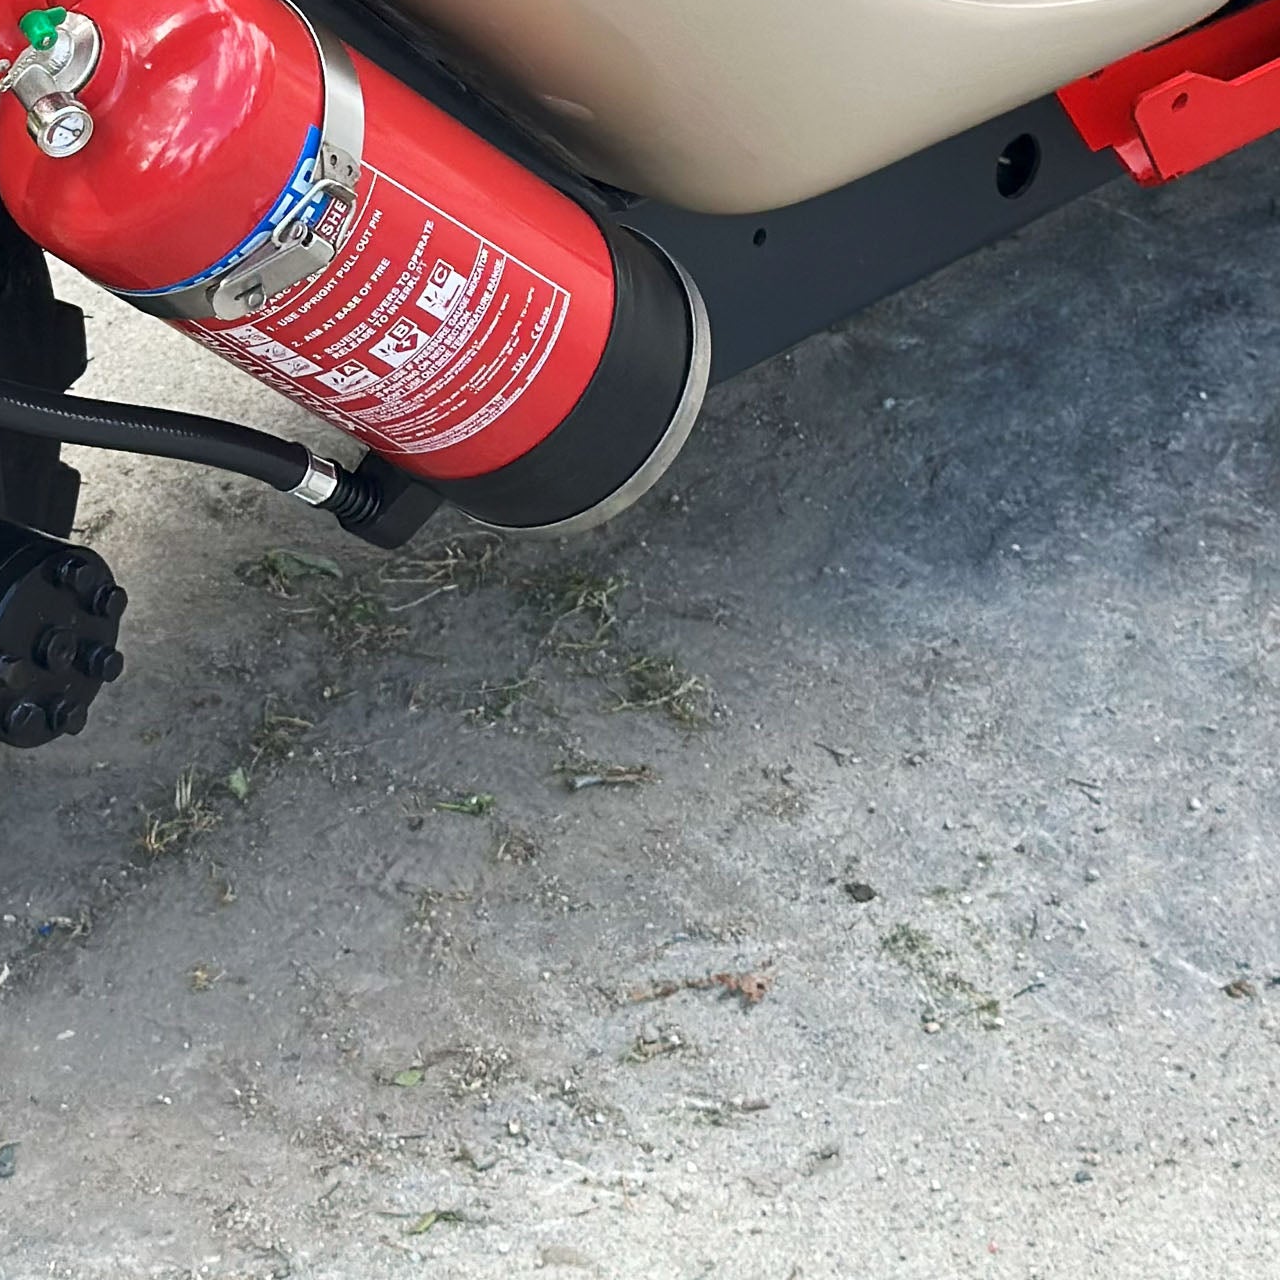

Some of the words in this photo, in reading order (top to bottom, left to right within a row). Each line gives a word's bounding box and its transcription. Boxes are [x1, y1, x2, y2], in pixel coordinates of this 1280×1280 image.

[277, 313, 300, 327] USE
[300, 278, 339, 314] UPRIGHT
[336, 254, 360, 279] PULL
[355, 229, 374, 253] OUT
[369, 209, 383, 231] PIN
[304, 329, 324, 342] AIM
[322, 319, 337, 331] AT
[335, 296, 363, 320] BASE
[359, 282, 374, 296] OF
[370, 257, 391, 283] FIRE
[324, 322, 368, 354] SQUEEZE
[368, 285, 401, 323] LEVERS
[397, 271, 411, 286] TO
[408, 219, 434, 271] OPERATE
[433, 266, 448, 283] C
[332, 329, 376, 360] RELEASE
[373, 314, 389, 329] TO
[395, 325, 409, 337] B
[412, 327, 452, 365] PRESSURE
[448, 297, 471, 327] GAUGE
[421, 352, 453, 379] OUTSIDE
[450, 290, 491, 350] TEMPERATURE
[343, 365, 361, 375] A
